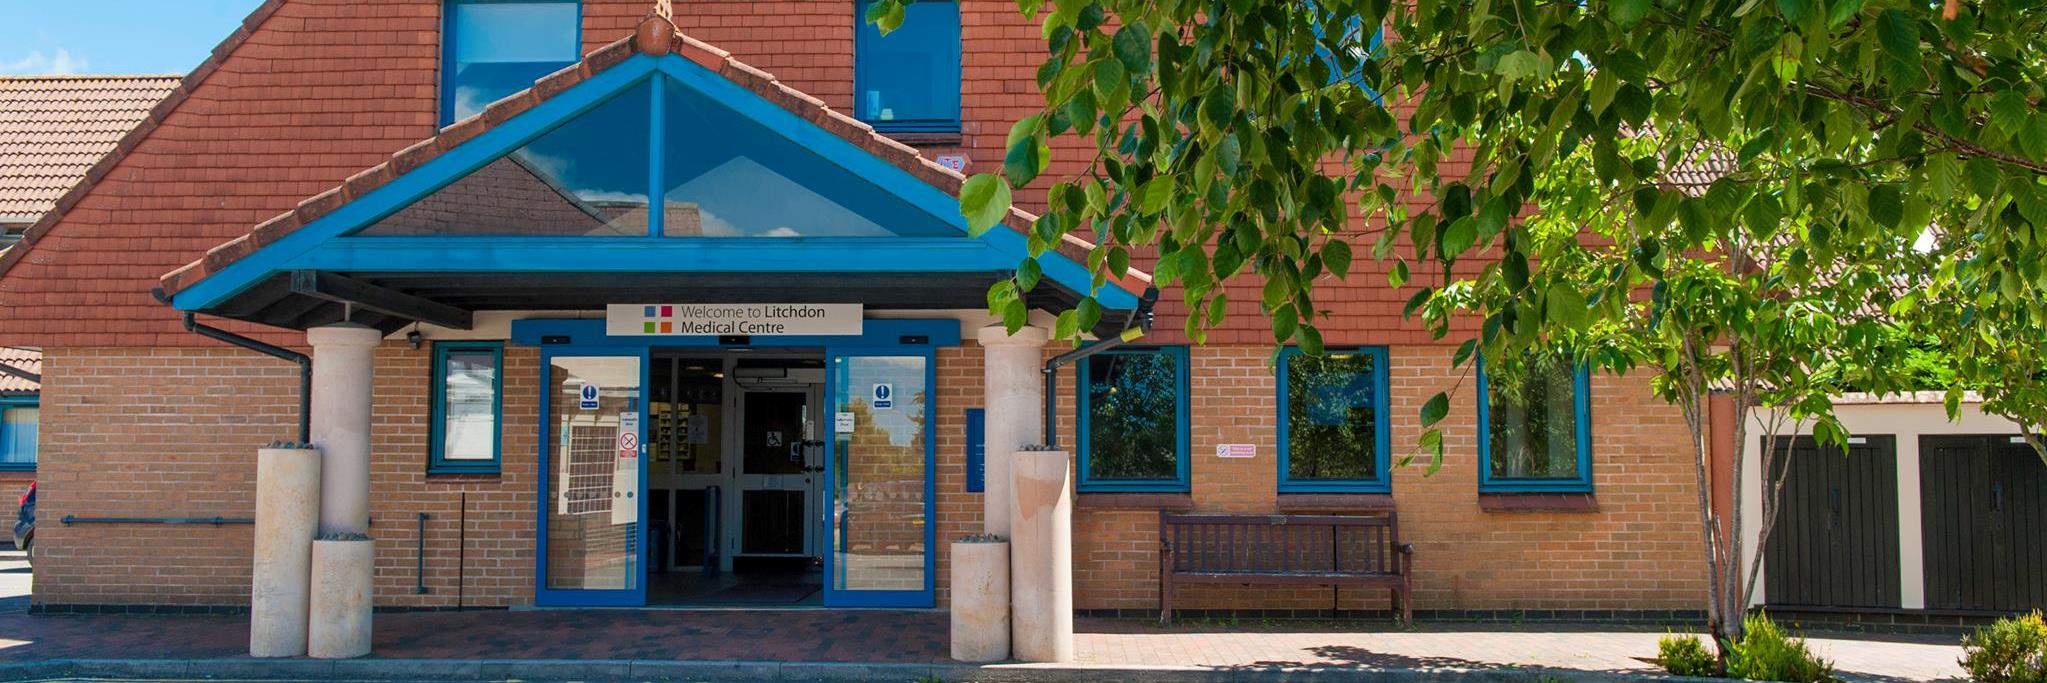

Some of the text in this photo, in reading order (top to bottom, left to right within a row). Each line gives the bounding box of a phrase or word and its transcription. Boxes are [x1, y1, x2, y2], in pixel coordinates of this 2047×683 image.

[681, 305, 825, 318] Welcome to Litchdon
[681, 320, 784, 333] Medical Centre
